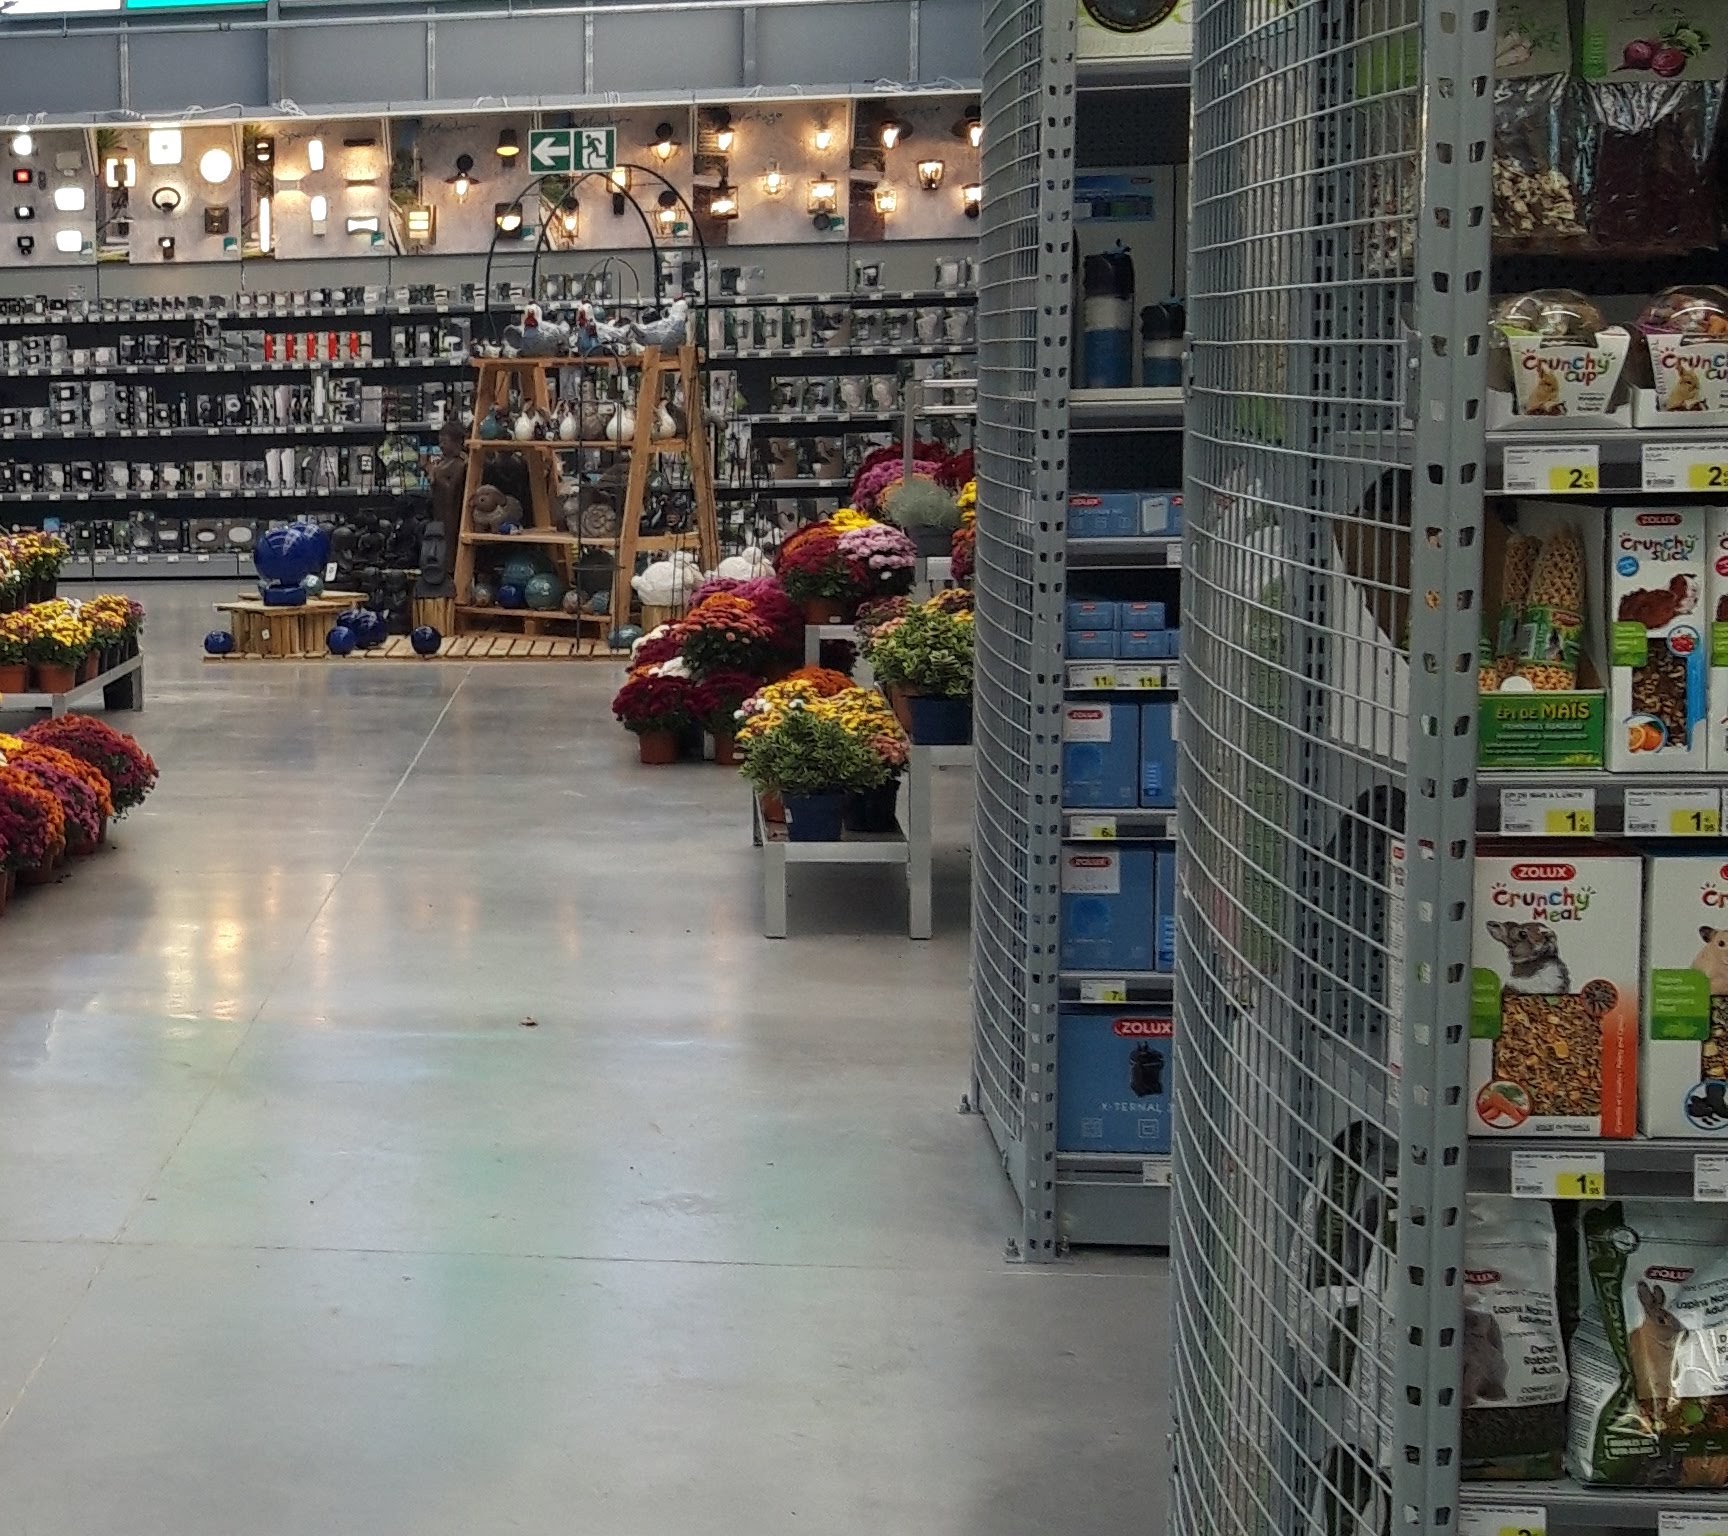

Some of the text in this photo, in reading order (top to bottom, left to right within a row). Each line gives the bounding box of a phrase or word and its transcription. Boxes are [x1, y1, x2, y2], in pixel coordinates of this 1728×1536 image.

[1522, 350, 1611, 375] Crunchy
[1569, 468, 1584, 489] 2
[1708, 466, 1723, 487] 2
[1620, 535, 1696, 554] Crunchy
[1565, 811, 1577, 832] 1
[1690, 811, 1702, 831] 1
[1518, 866, 1569, 878] ZOLUX
[1492, 886, 1591, 911] Crunchy
[1121, 1021, 1172, 1034] ZOLUX
[1576, 1174, 1587, 1194] 1
